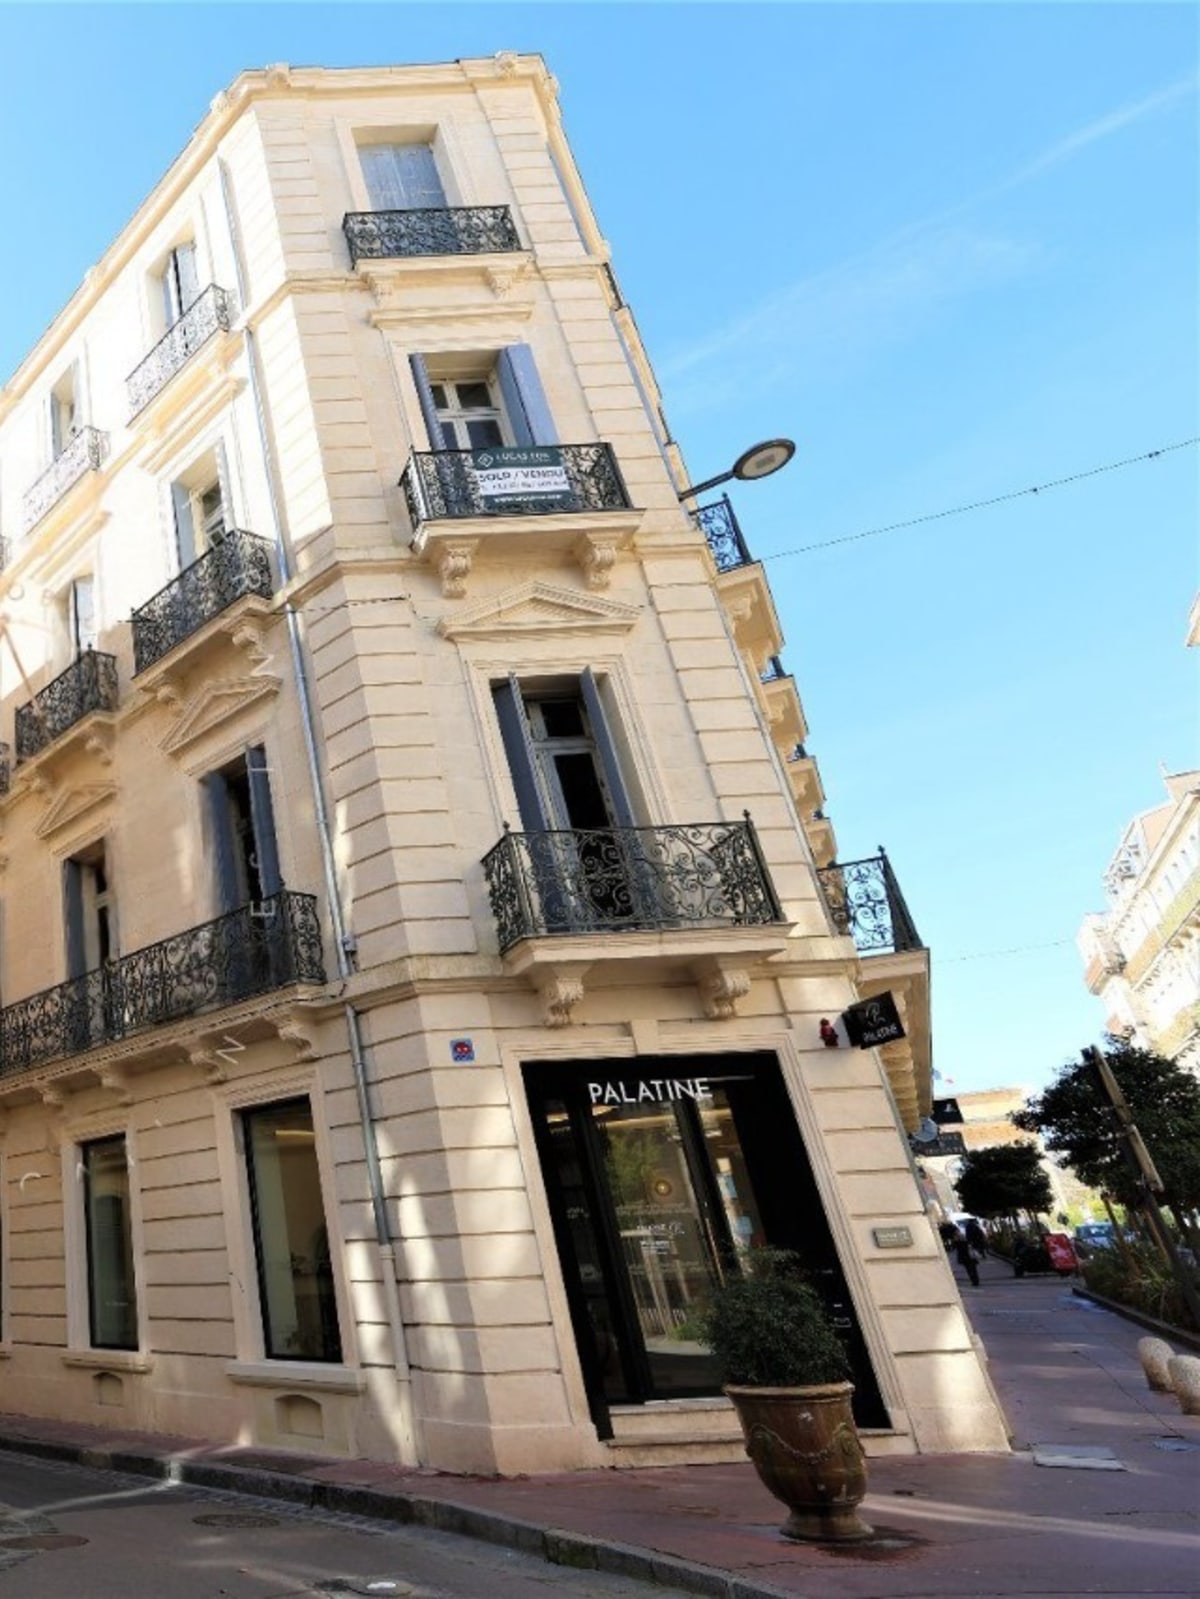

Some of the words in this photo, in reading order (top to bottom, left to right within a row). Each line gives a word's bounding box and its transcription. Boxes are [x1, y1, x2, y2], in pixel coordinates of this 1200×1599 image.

[479, 472, 511, 482] SOLD
[520, 469, 563, 479] VENDU
[587, 1077, 713, 1104] PALATINE
